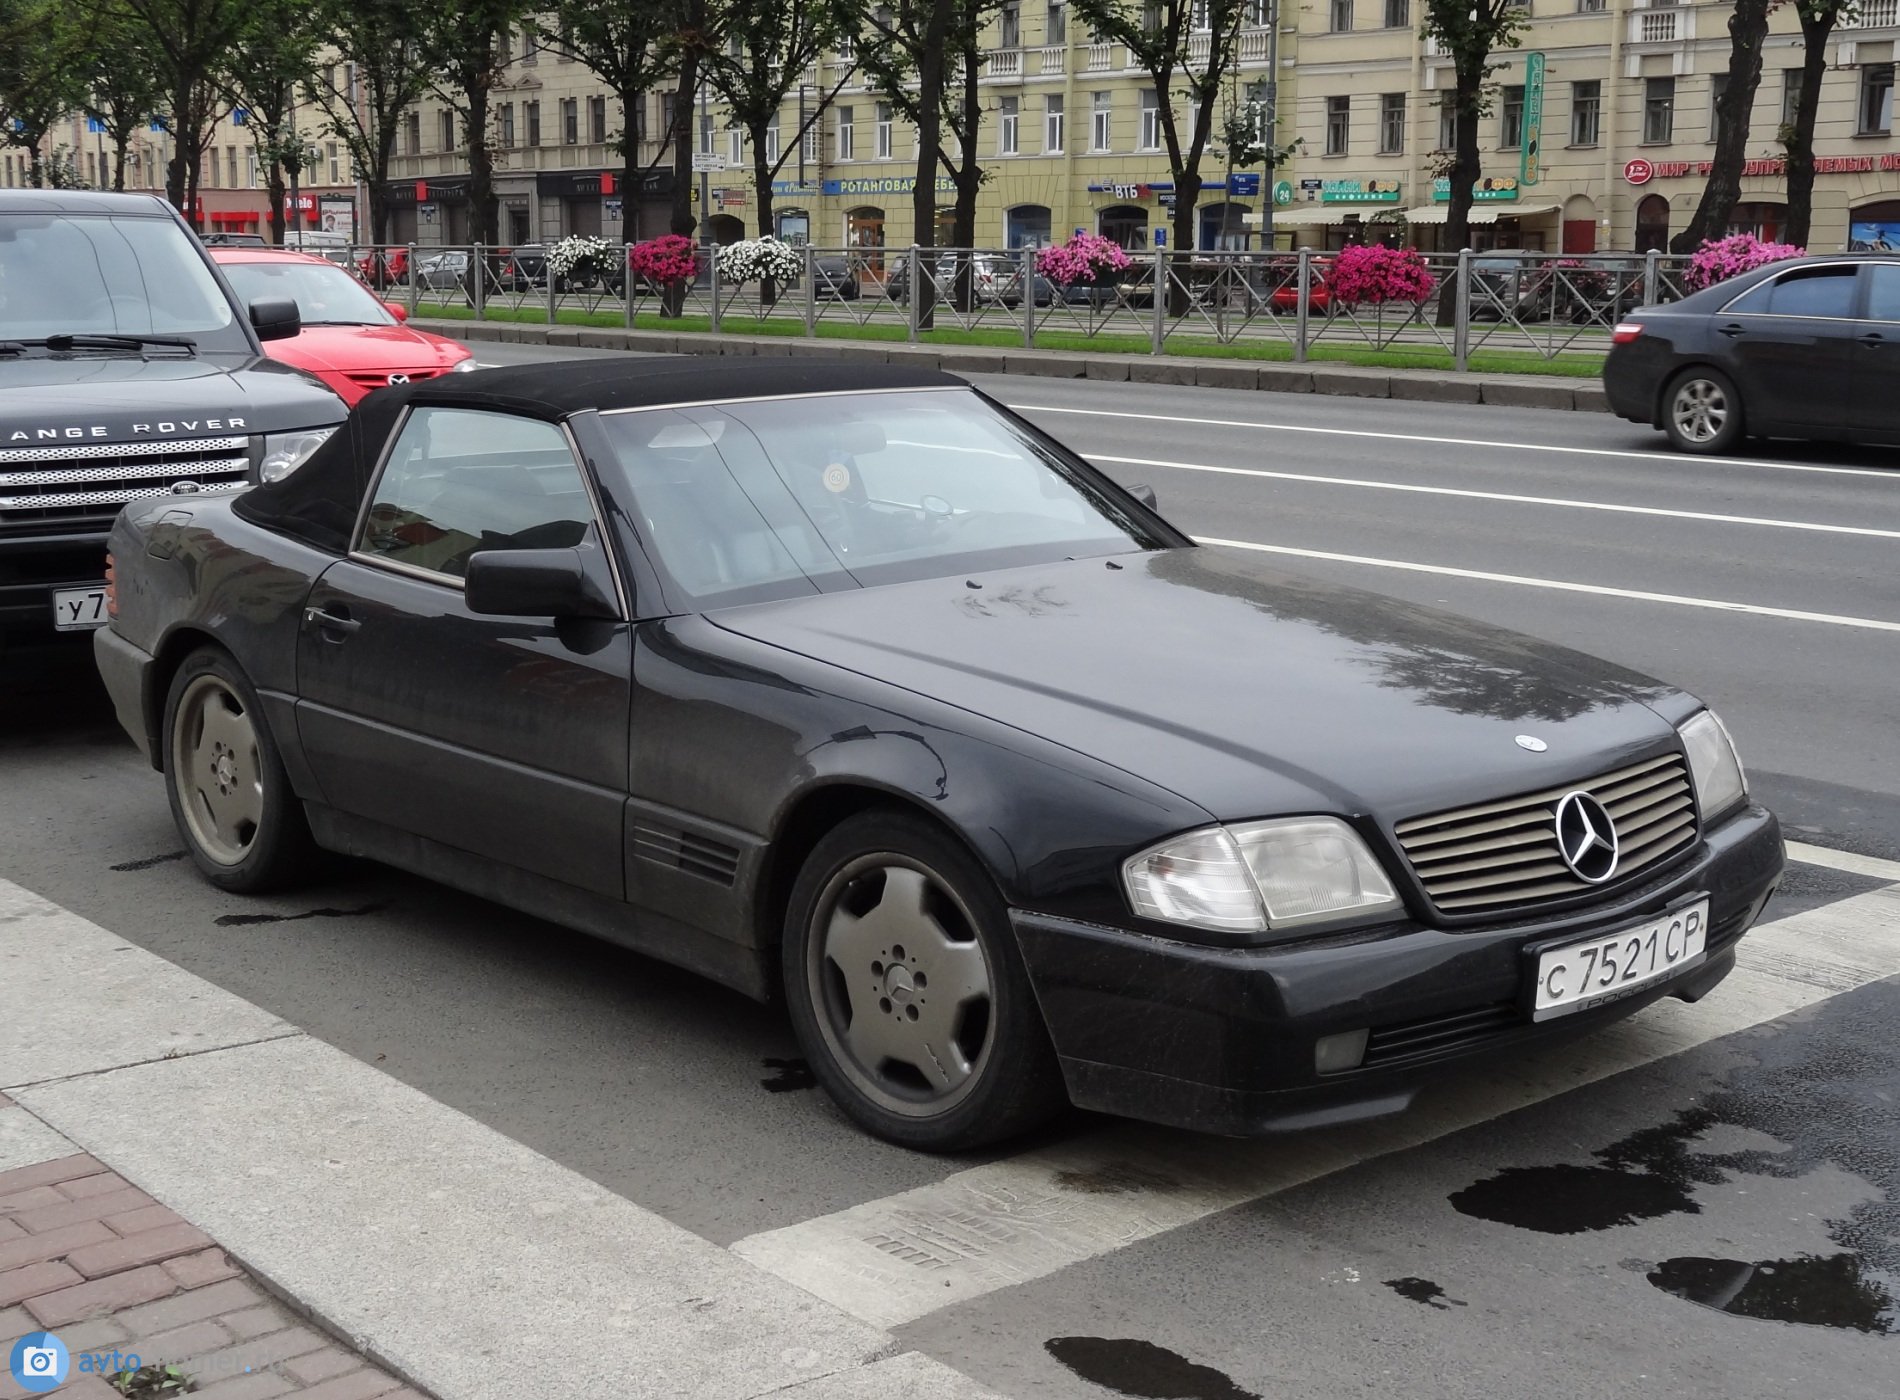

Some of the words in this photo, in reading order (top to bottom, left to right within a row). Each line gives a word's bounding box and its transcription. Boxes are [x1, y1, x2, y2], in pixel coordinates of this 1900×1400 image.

[1657, 161, 1689, 177] МИР
[841, 178, 917, 192] РОТАНГОВАЯ
[1279, 190, 1290, 201] 24
[7, 426, 108, 440] ANGE
[133, 418, 246, 434] ROVER
